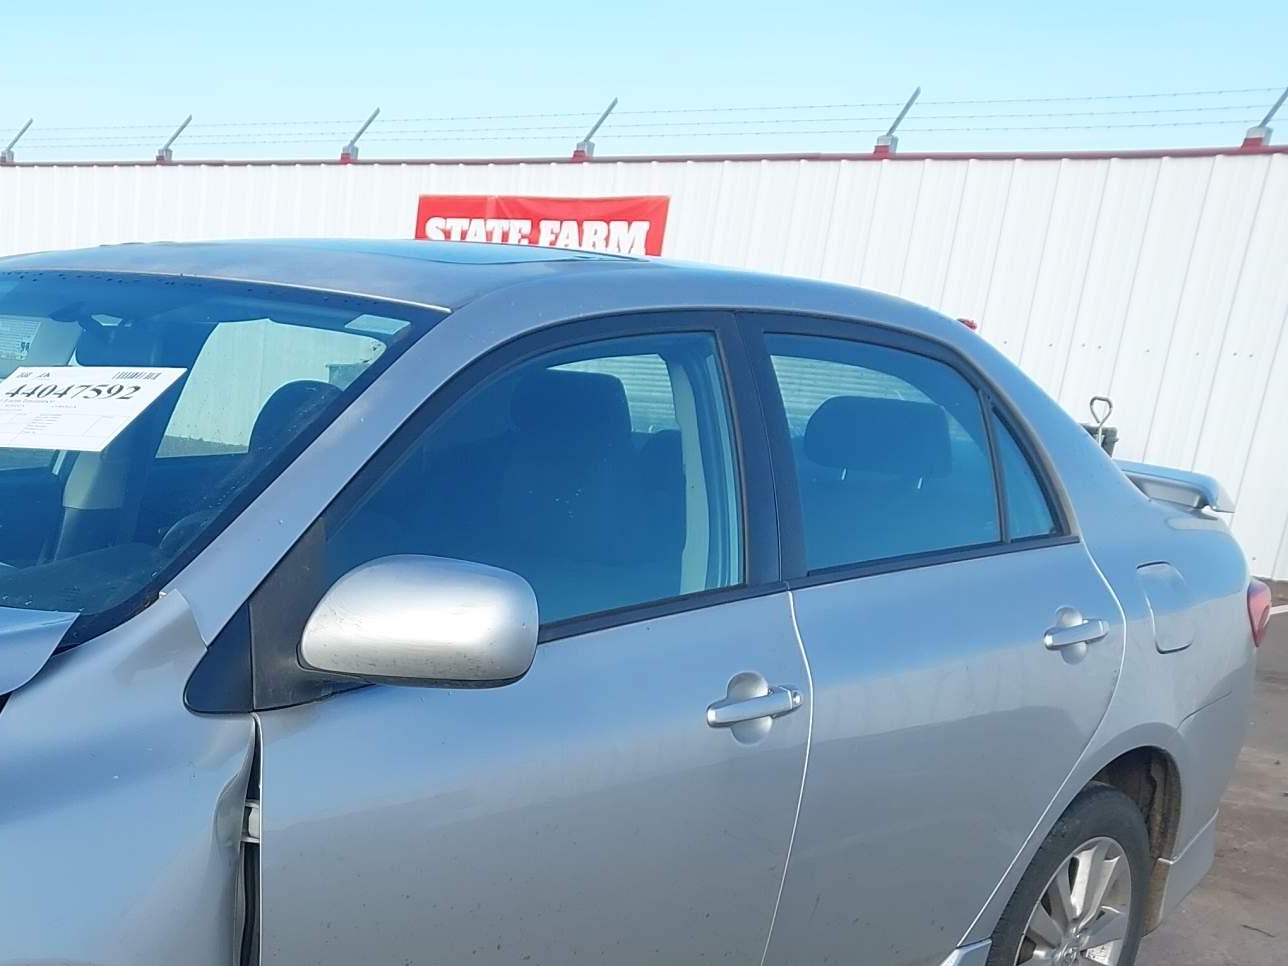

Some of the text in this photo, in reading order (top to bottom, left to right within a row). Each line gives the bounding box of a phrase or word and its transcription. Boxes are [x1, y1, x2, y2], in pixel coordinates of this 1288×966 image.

[425, 216, 650, 256] STATE FARM
[5, 384, 141, 399] 44047592
